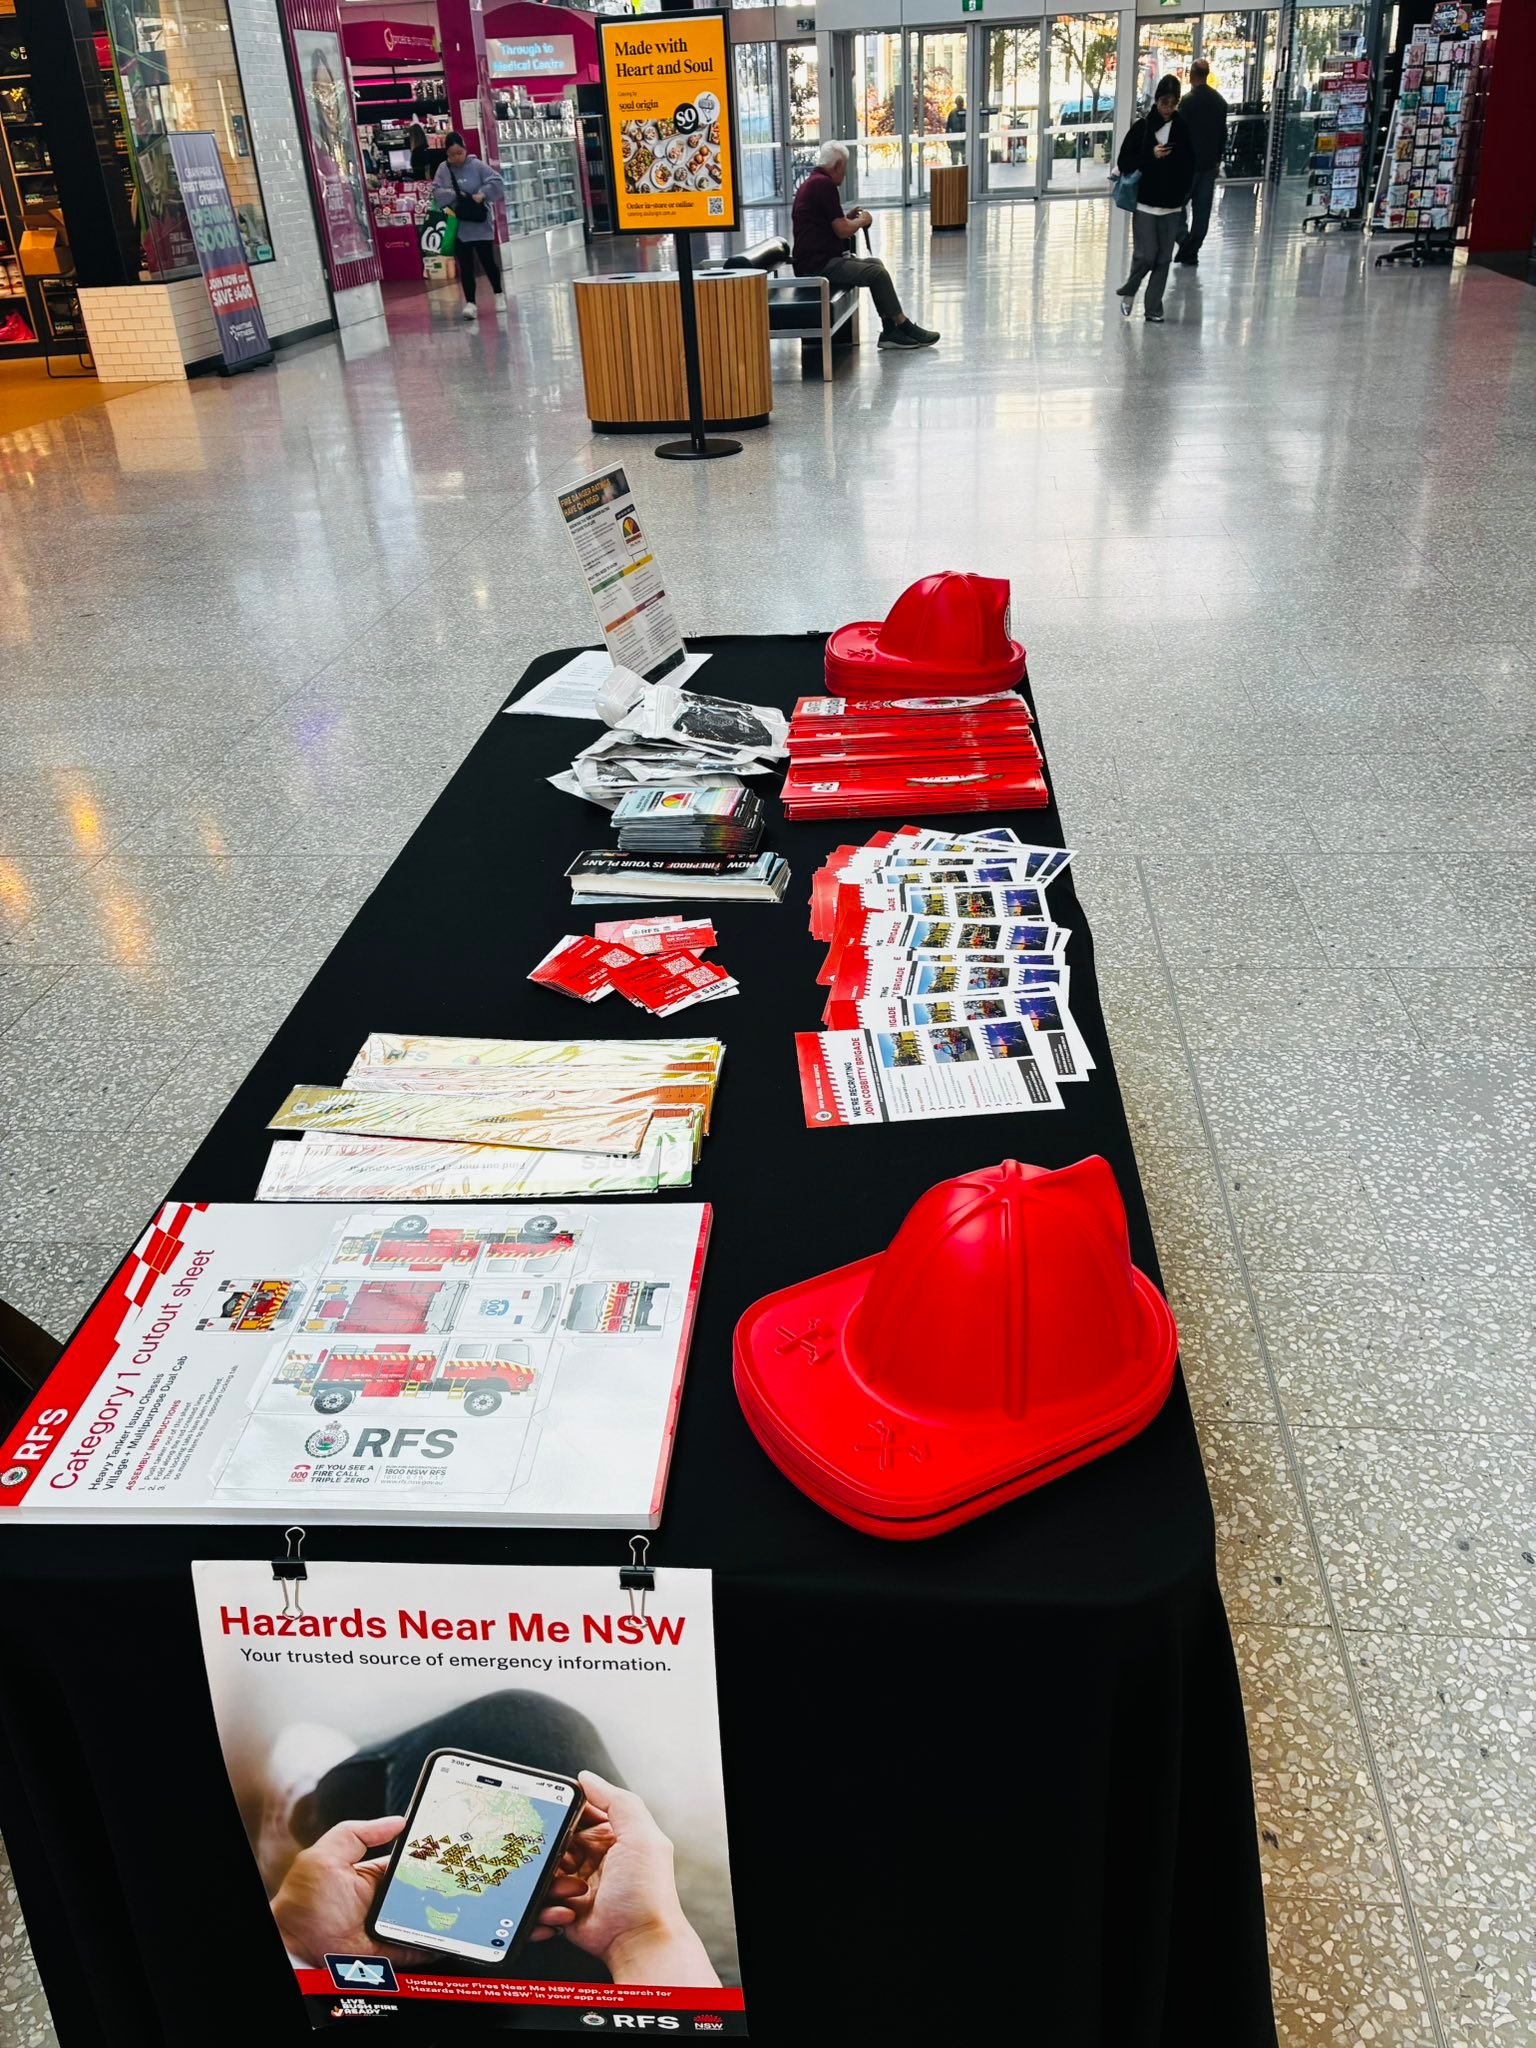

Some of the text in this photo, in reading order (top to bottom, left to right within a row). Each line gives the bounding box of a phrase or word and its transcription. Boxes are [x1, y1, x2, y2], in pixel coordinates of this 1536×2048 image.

[500, 42, 554, 56] Through to
[615, 38, 688, 56] Made with
[492, 59, 564, 72] Medical Centre
[616, 58, 713, 78] Heart and Soul
[619, 100, 658, 111] soul origin
[209, 277, 222, 290] JOIN
[222, 274, 238, 287] NOW
[212, 288, 234, 307] SAVE
[576, 494, 600, 510] CHANGED
[667, 862, 721, 870] FIREPROOF
[887, 922, 902, 944] BRIGADE
[702, 984, 720, 995] RFS
[892, 967, 906, 991] BRIGADE
[388, 1050, 430, 1062] RFS
[852, 1038, 875, 1116] JOIN COBBITTY BRIGADE
[844, 1062, 861, 1118] WE'RE RECRUITING
[50, 1386, 134, 1489] Category
[132, 1303, 184, 1364] cutout
[172, 1250, 215, 1298] sheet
[12, 1408, 68, 1460] RFS
[88, 1373, 164, 1490] Heavy Tanker Isuzu Chassis
[102, 1458, 129, 1490] Village
[127, 1393, 166, 1449] Multipurpose
[160, 1373, 178, 1392] Dual
[172, 1356, 188, 1372] Cab
[178, 1454, 192, 1472] match
[188, 1438, 200, 1453] them
[200, 1418, 210, 1431] their
[218, 1374, 234, 1394] locking
[126, 1400, 182, 1490] ASSEMBLY INSTRUCTIONS
[144, 1464, 158, 1480] Push
[154, 1446, 167, 1464] tanker
[174, 1417, 184, 1428] this
[180, 1402, 192, 1416] sheet
[162, 1468, 174, 1480] The
[170, 1446, 187, 1469] locking
[182, 1434, 194, 1446] tabs
[189, 1420, 200, 1433] have
[196, 1406, 208, 1420] been
[352, 1428, 458, 1458] RFS
[153, 1467, 166, 1480] Fold
[163, 1450, 176, 1466] along
[171, 1440, 180, 1450] the
[178, 1429, 186, 1439] red
[220, 1606, 686, 1646] Hazards Near Me NSW
[240, 1648, 672, 1673] Your trusted source of emergency information.
[406, 1978, 444, 1986] Update
[407, 1986, 454, 1994] 'Hazards
[612, 2014, 680, 2030] RFS
